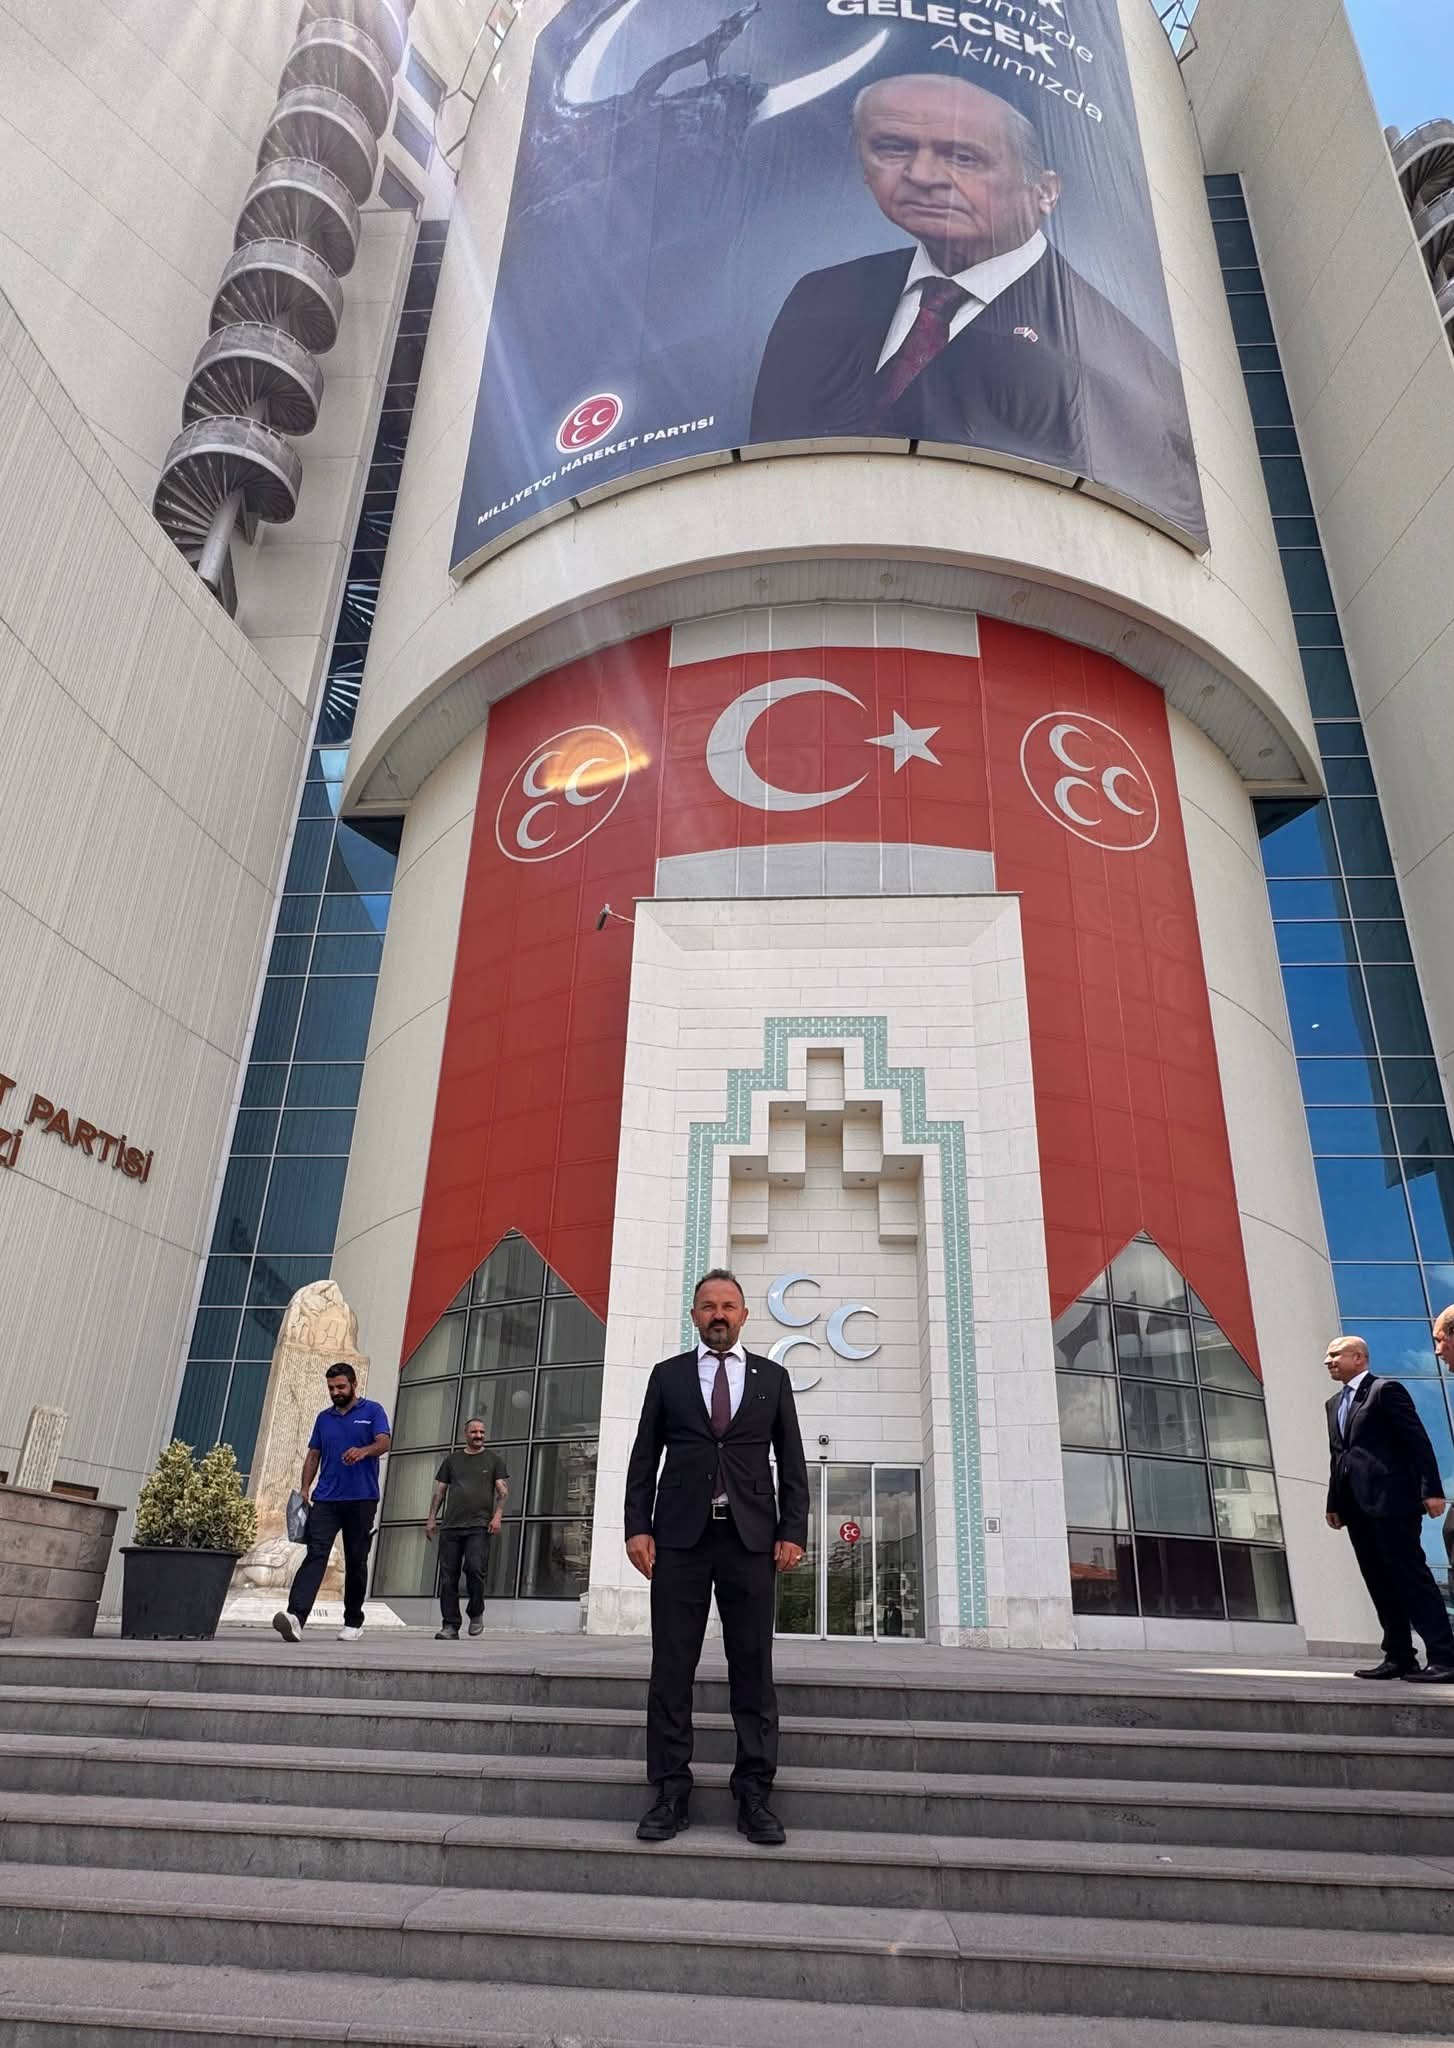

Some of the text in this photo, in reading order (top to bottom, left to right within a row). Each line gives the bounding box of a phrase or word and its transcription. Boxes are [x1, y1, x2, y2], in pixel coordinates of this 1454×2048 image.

[826, 0, 1056, 68] GELECEK
[931, 34, 1103, 122] Aklımızda
[560, 436, 639, 476] HAREKET
